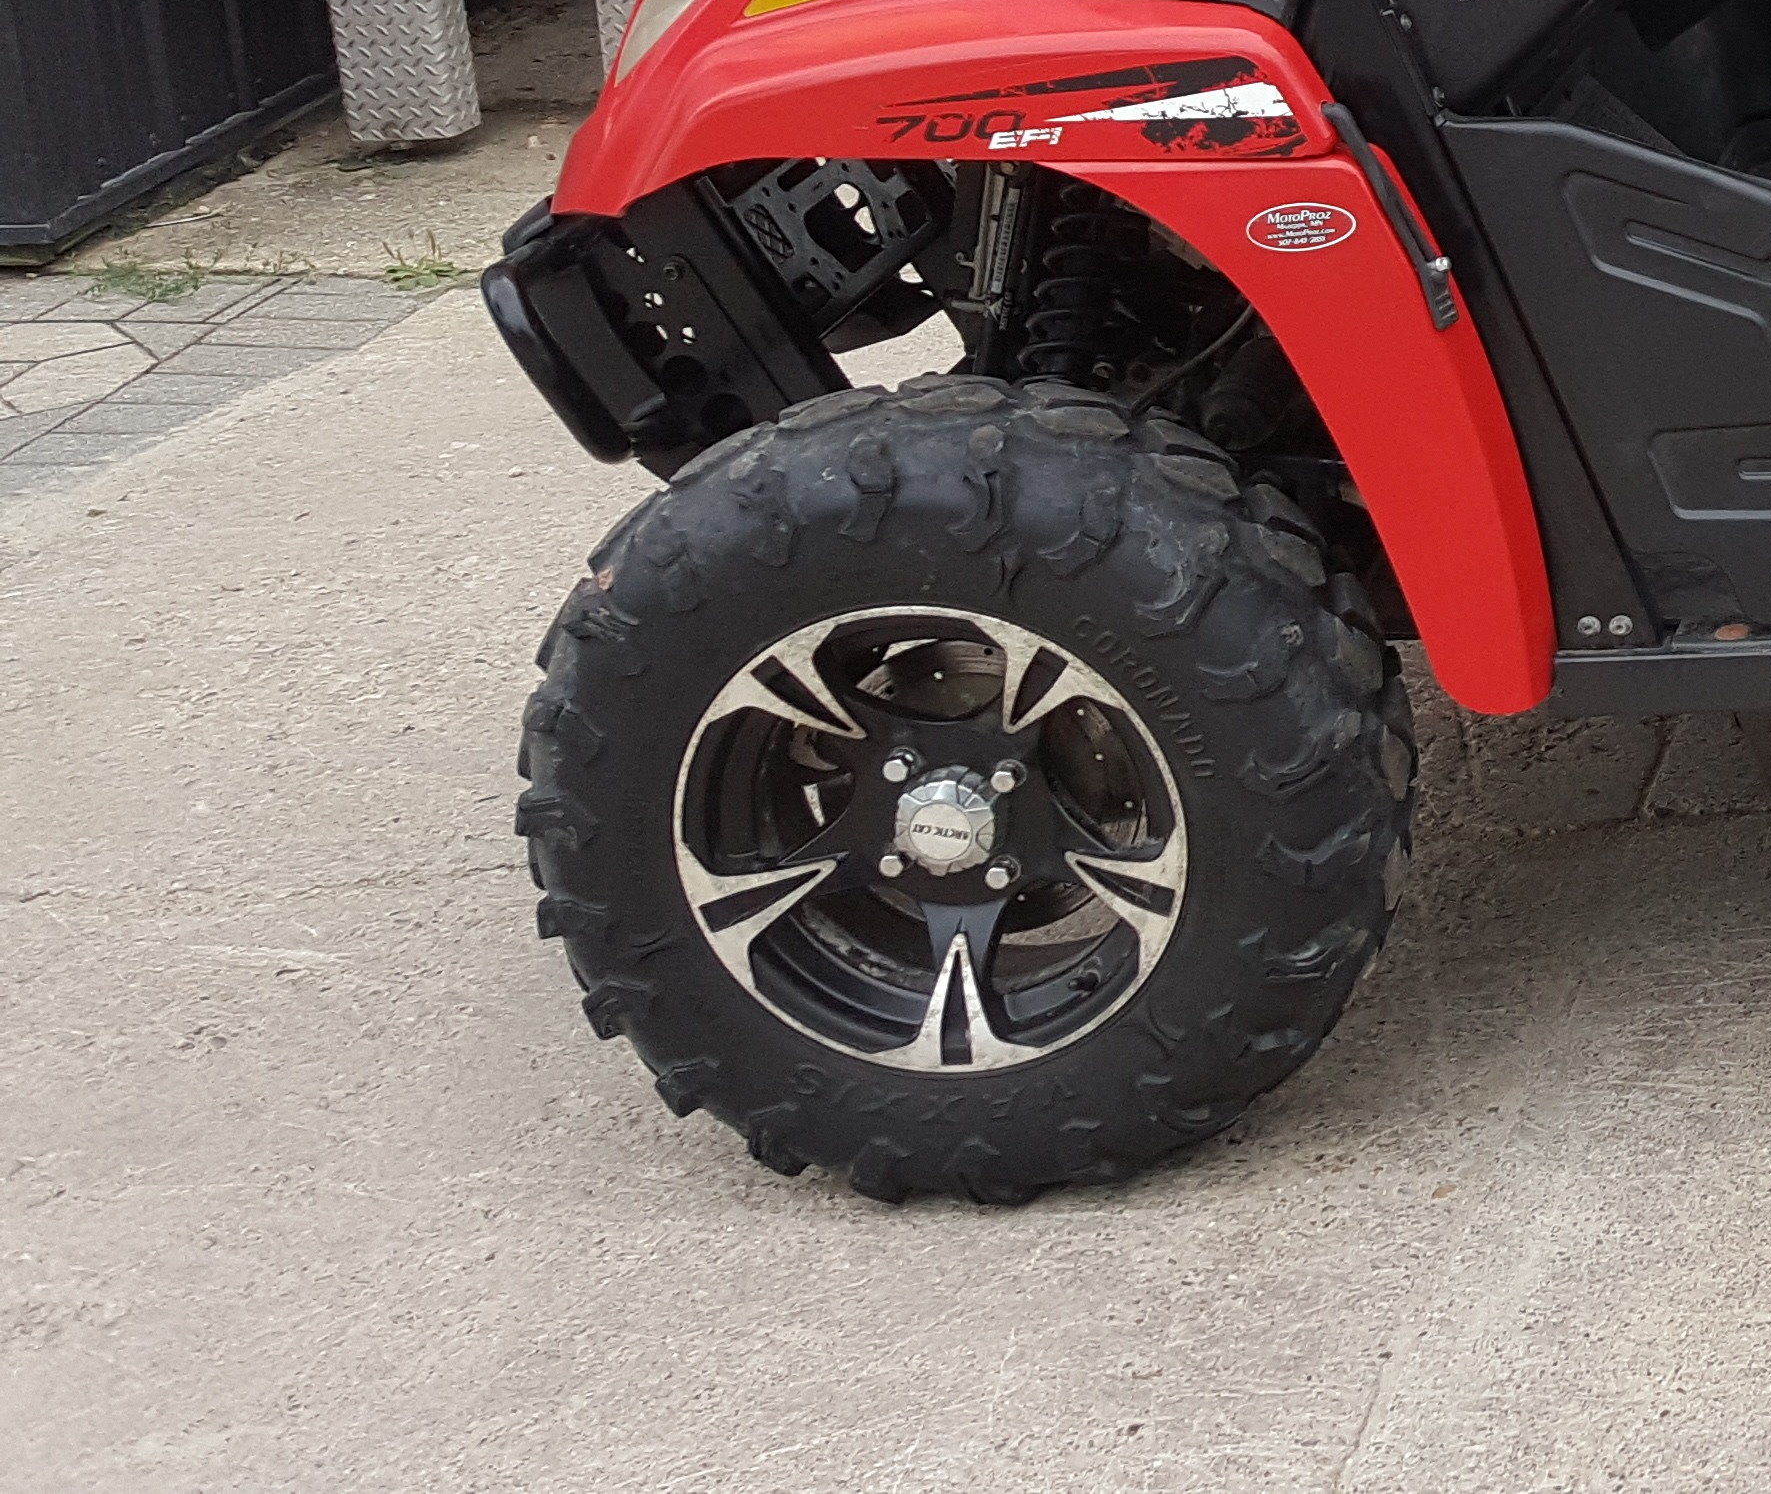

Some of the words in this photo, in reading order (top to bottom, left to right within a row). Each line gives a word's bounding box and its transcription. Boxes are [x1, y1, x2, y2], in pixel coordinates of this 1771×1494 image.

[876, 110, 1027, 143] 700
[912, 824, 931, 835] CAT
[932, 827, 970, 841] ARCTIC
